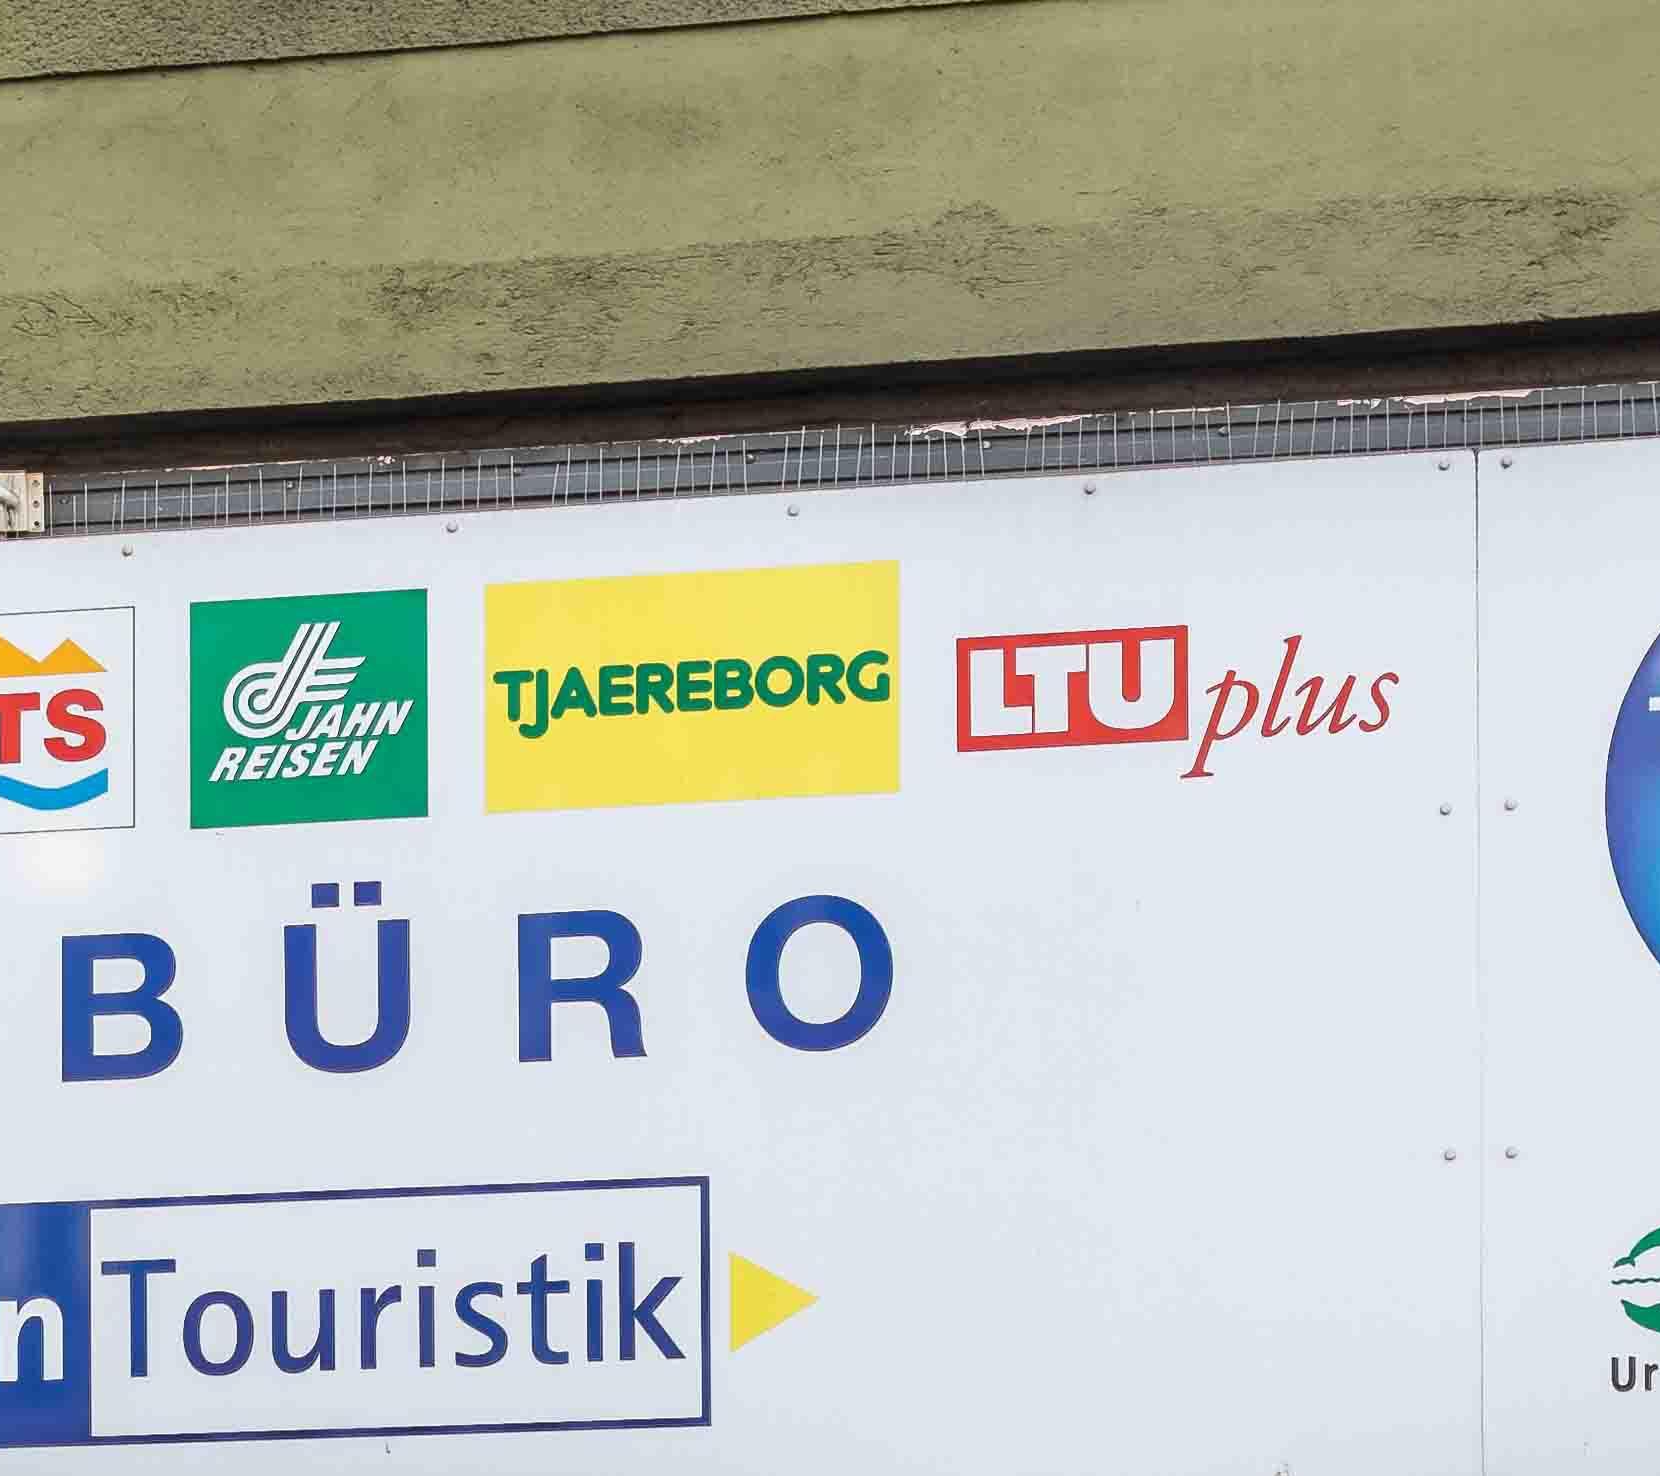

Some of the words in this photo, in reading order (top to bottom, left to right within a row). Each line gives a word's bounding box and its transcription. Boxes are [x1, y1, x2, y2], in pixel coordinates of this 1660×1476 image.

[286, 697, 413, 742] JAHN
[492, 650, 890, 738] TJAEREBORG
[962, 630, 1177, 747] LTU
[1181, 635, 1400, 779] plus
[209, 738, 379, 784] REISEN
[100, 1239, 686, 1384] Touristik
